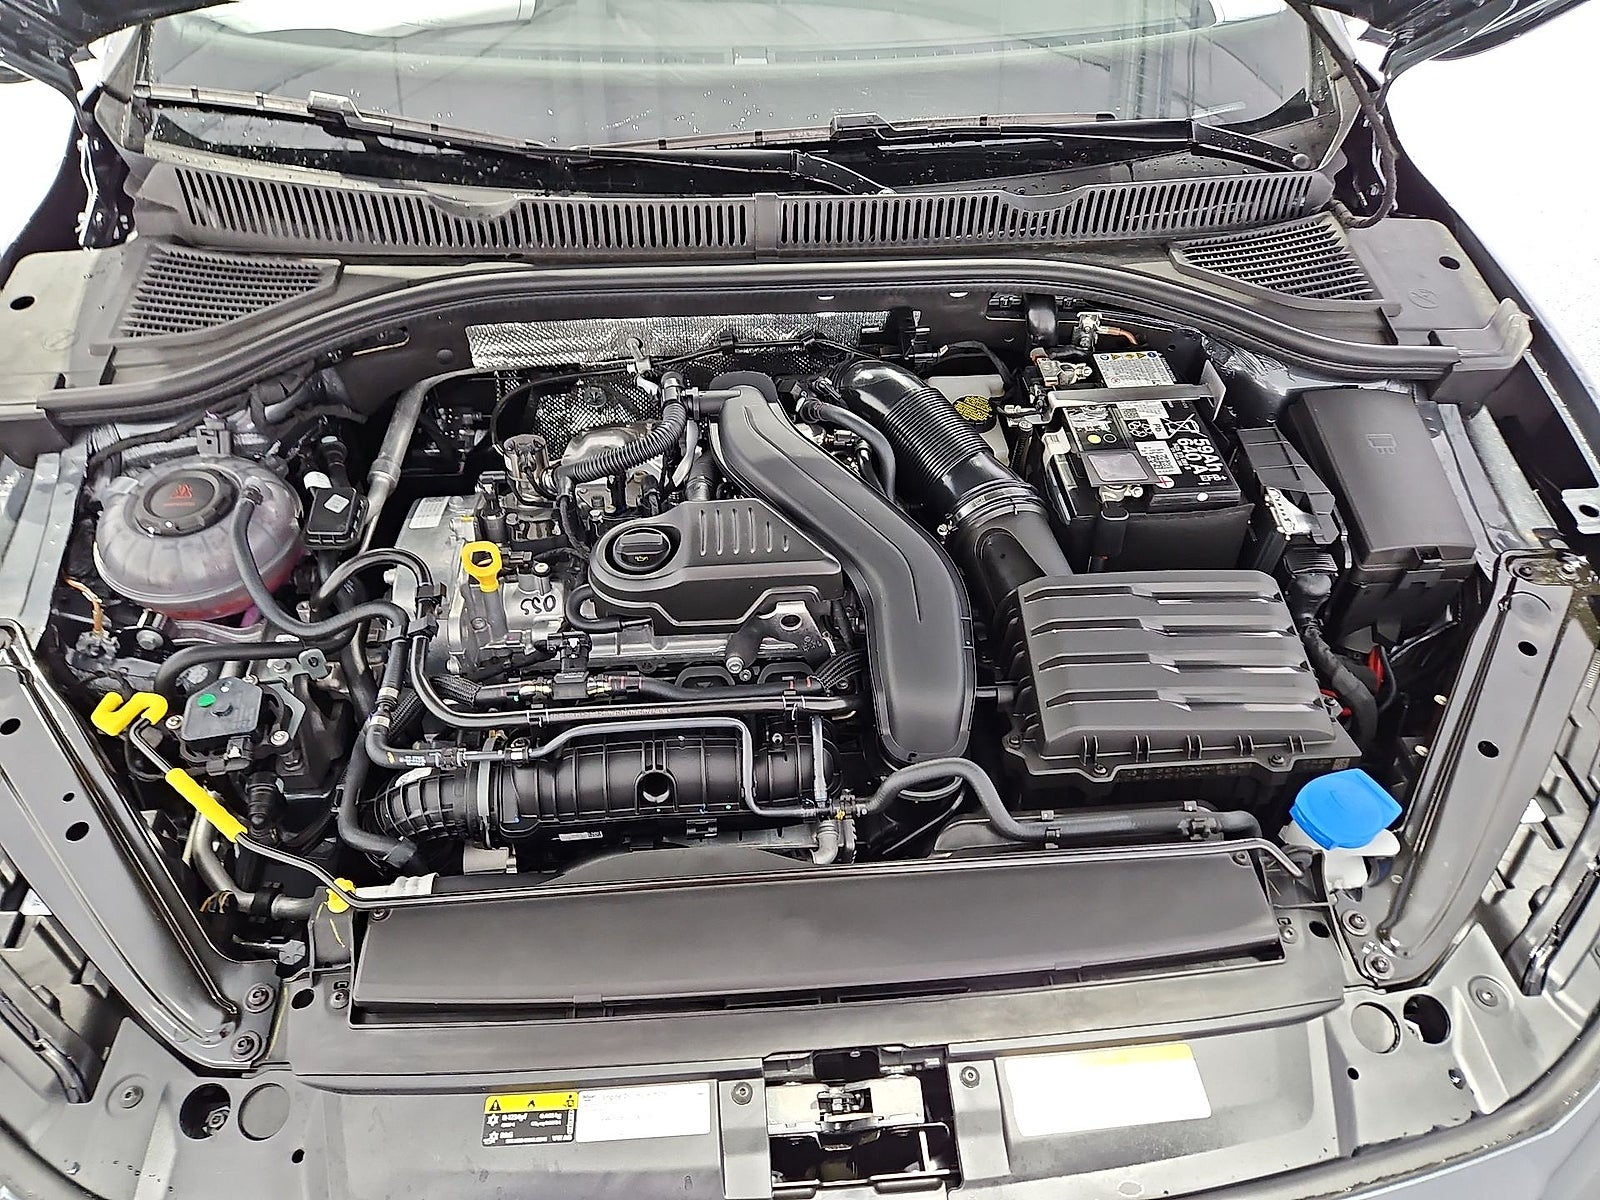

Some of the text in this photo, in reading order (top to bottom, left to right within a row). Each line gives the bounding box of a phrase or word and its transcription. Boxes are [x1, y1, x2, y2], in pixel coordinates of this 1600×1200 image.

[1152, 423, 1162, 432] Pb
[1177, 437, 1203, 461] 640
[1190, 463, 1209, 475] A
[1193, 438, 1224, 473] 59Ah
